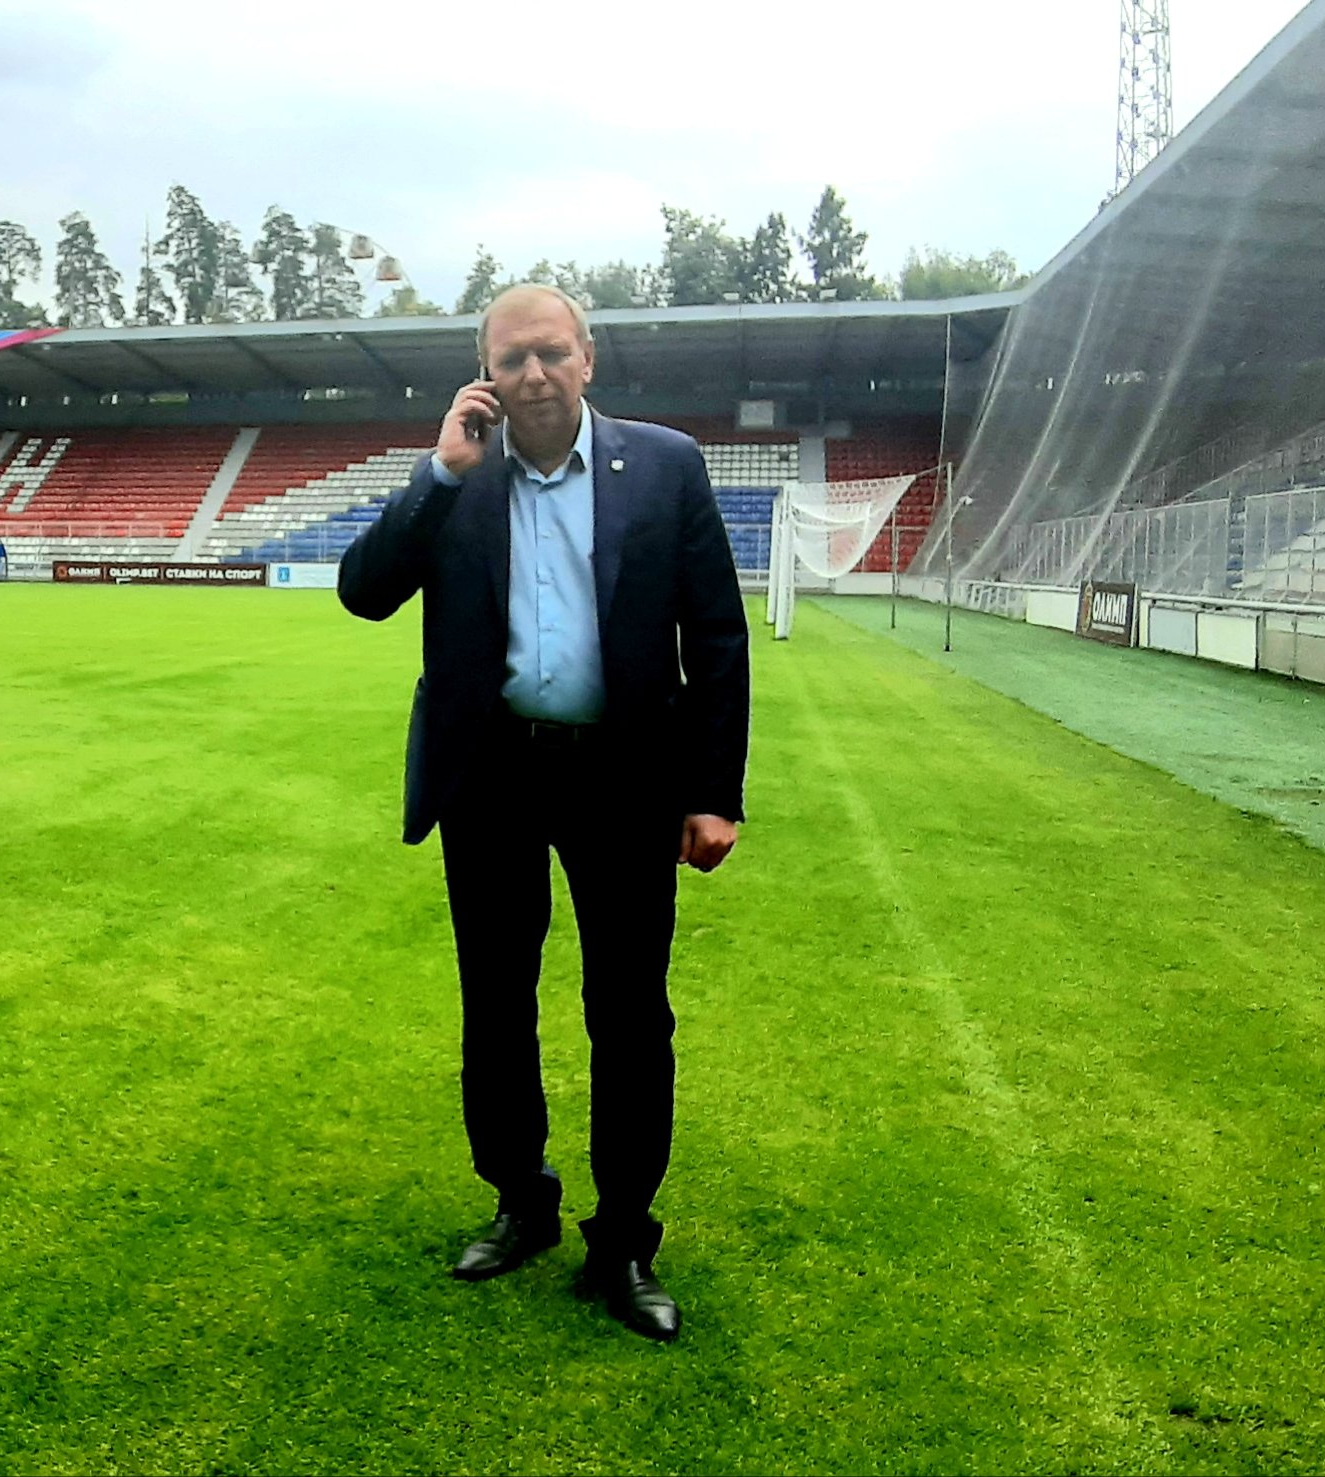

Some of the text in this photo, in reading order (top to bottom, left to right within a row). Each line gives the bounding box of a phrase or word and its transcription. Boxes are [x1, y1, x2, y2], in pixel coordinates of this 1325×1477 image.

[165, 568, 208, 579] СТАВКИ
[209, 569, 224, 579] НА
[225, 569, 262, 580] СПОРТ
[1092, 591, 1128, 625] ОЛИМП
